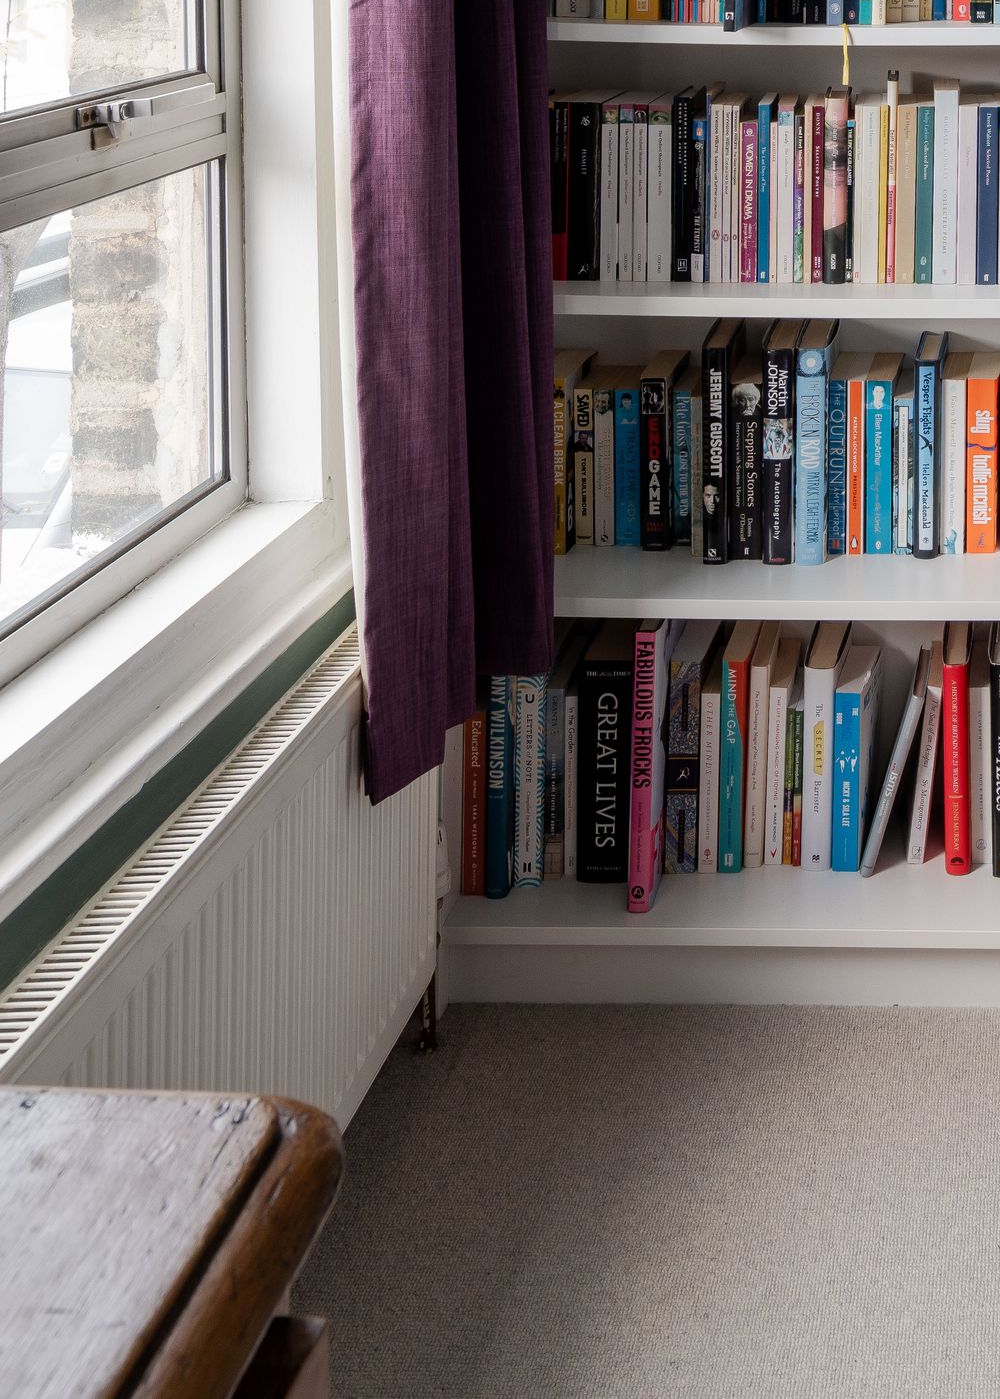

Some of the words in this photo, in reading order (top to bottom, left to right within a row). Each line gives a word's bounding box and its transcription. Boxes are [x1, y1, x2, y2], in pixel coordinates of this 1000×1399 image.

[745, 180, 753, 188] IN
[744, 190, 752, 220] DRAMA
[709, 368, 722, 418] JEREMY
[768, 361, 778, 415] JOHNSON
[778, 370, 788, 406] Martin
[922, 372, 932, 404] Vesper
[577, 395, 589, 426] SAVED
[676, 396, 690, 418] Pete
[874, 414, 882, 430] Ellen
[920, 406, 932, 434] Flights
[970, 410, 994, 434] slug
[554, 412, 564, 447] CLEAN
[677, 421, 690, 446] Goss
[746, 422, 757, 468] Stepping
[830, 408, 844, 484] OUTRUN
[709, 422, 722, 478] GUSCOTT
[874, 432, 882, 466] MacArthur
[554, 450, 564, 485] BREAK
[922, 464, 930, 486] Helen
[972, 455, 991, 483] hollie
[746, 472, 757, 507] Stones
[972, 484, 991, 524] mcnish
[922, 490, 930, 528] Macdonald
[490, 676, 506, 704] NNY
[634, 641, 654, 720] FABULOUS
[728, 669, 736, 700] MIND
[596, 692, 618, 774] GREAT
[726, 720, 736, 744] GAP
[952, 714, 958, 722] OF
[471, 720, 481, 768] Educated
[489, 709, 505, 790] WILKINSON
[632, 727, 652, 788] FROCKS
[813, 780, 822, 812] Barrister
[595, 782, 616, 848] LIVES
[952, 821, 960, 850] MURRAY
